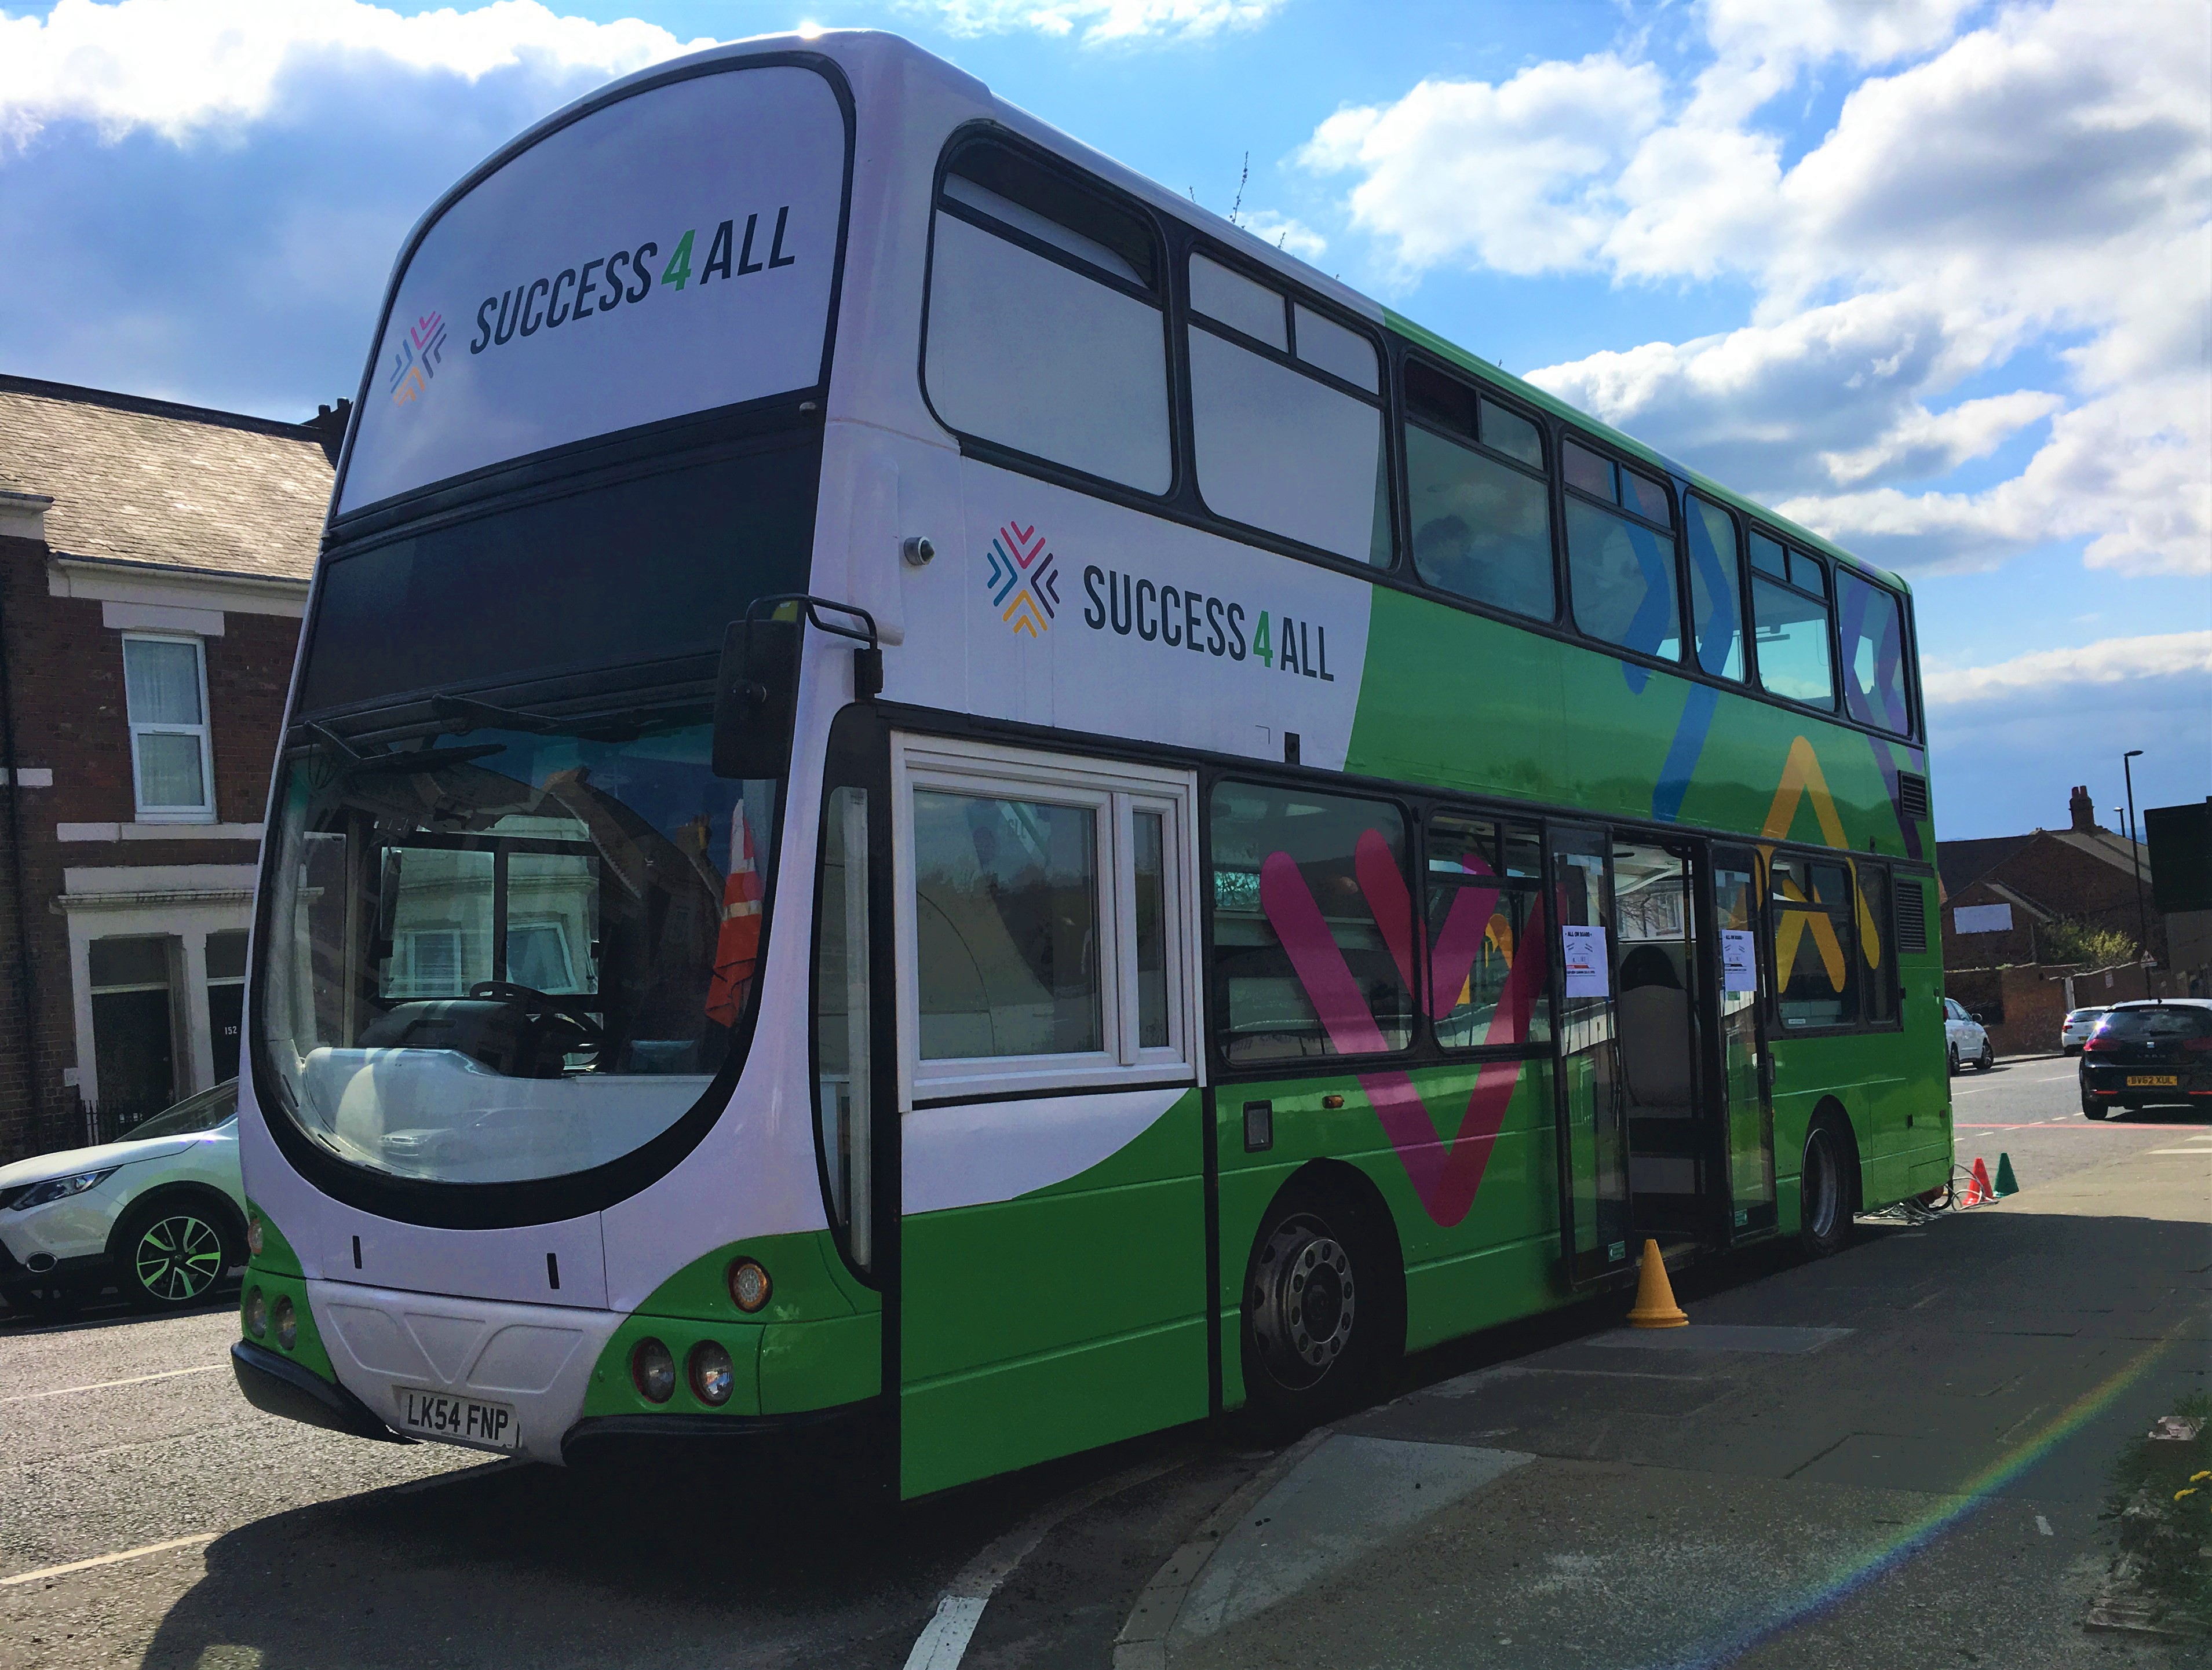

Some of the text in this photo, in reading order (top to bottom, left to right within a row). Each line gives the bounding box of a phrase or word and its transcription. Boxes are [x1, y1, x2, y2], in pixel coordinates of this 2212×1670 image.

[225, 1026, 238, 1035] 152
[407, 1394, 509, 1441] LK54 FNP
